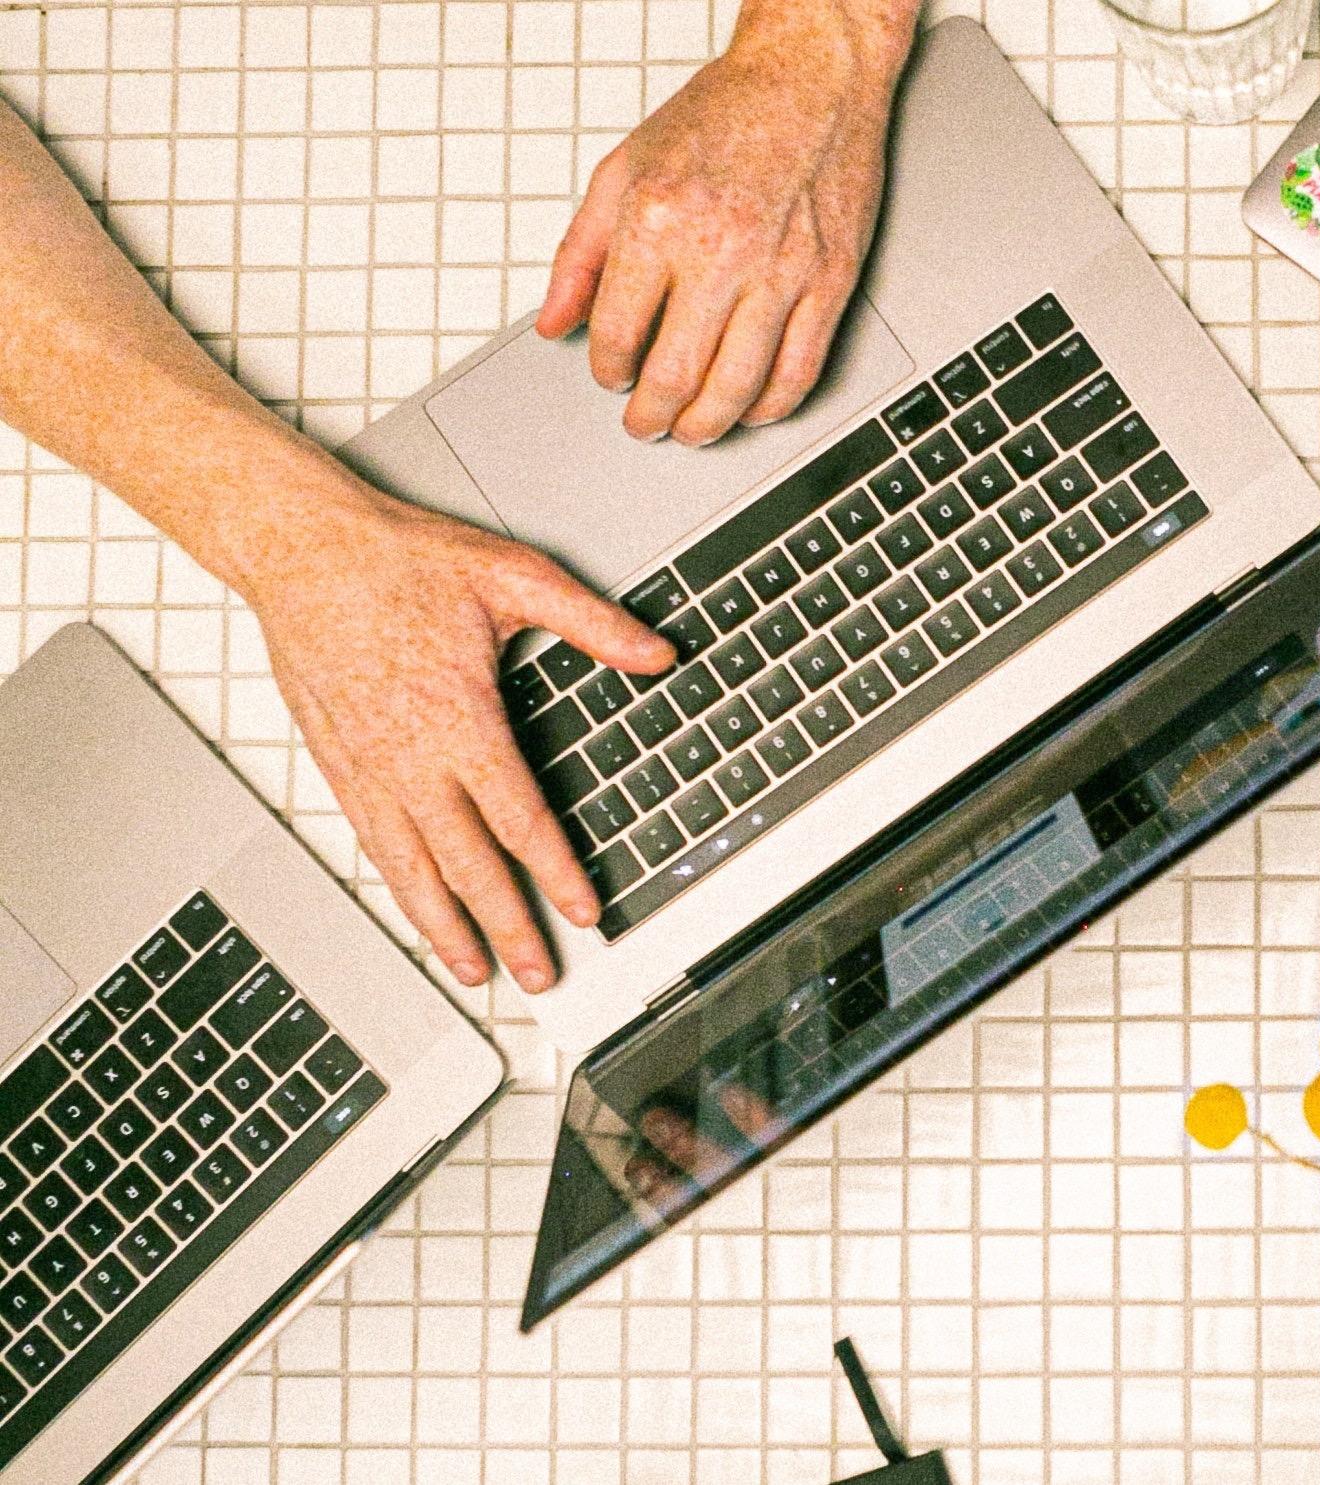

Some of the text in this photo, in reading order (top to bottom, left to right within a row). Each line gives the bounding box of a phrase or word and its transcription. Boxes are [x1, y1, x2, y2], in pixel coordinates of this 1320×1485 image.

[1123, 419, 1138, 432] tab
[1060, 477, 1074, 491] Q
[722, 420, 985, 613] Z X C V B N M
[1019, 507, 1034, 522] W
[1064, 525, 1076, 539] 2
[978, 536, 990, 550] E
[1023, 555, 1035, 568] 3
[689, 445, 1033, 694] A S D F G H J K L
[936, 566, 950, 580] R
[981, 586, 992, 598] 4
[896, 598, 908, 610] T
[939, 615, 952, 628] 5
[855, 628, 866, 640] Y
[897, 645, 910, 658] 6
[810, 656, 825, 670] U
[858, 675, 869, 688] 7
[813, 704, 826, 718] 8
[727, 716, 740, 729] O
[772, 736, 784, 748] 9
[688, 746, 699, 759] P
[729, 765, 742, 778] 0
[289, 1007, 304, 1021] tab
[31, 1032, 154, 1154] Z X C V
[246, 1125, 258, 1137] 2
[6, 1049, 205, 1245] A S D F G H
[208, 1161, 221, 1174] 3
[12, 1077, 249, 1308] Q W E R T Y U
[172, 1199, 182, 1210] 4
[134, 1234, 147, 1247] 5
[97, 1270, 110, 1283] 6
[62, 1308, 73, 1320] 7
[22, 1343, 35, 1356] 8
